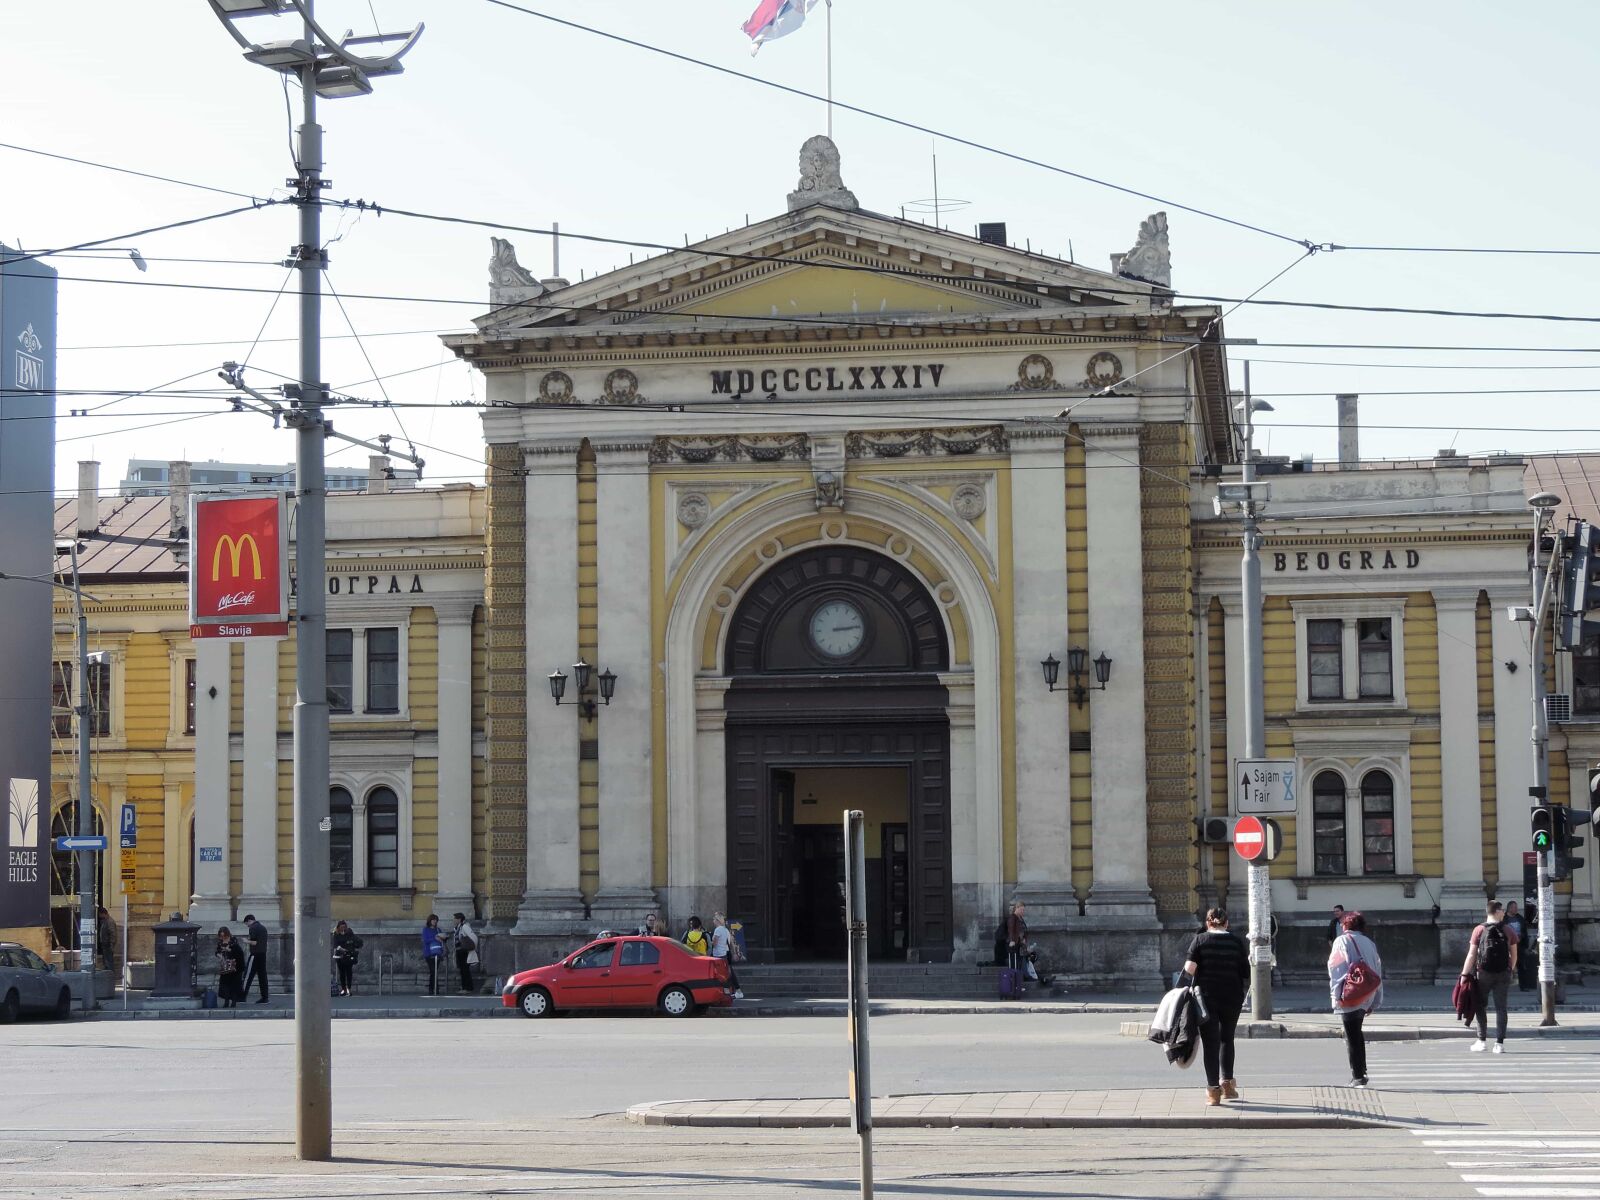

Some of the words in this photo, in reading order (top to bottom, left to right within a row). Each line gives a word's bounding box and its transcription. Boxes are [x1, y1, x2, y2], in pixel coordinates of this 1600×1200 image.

[18, 355, 41, 389] BW
[710, 363, 945, 394] MDCCCLXXXIV
[1273, 549, 1421, 571] BEOGRAD
[218, 625, 252, 637] Slavija
[1254, 769, 1280, 786] Sajam
[1254, 789, 1271, 803] Fair
[9, 851, 38, 866] EAGLE
[9, 867, 38, 882] HILLS
